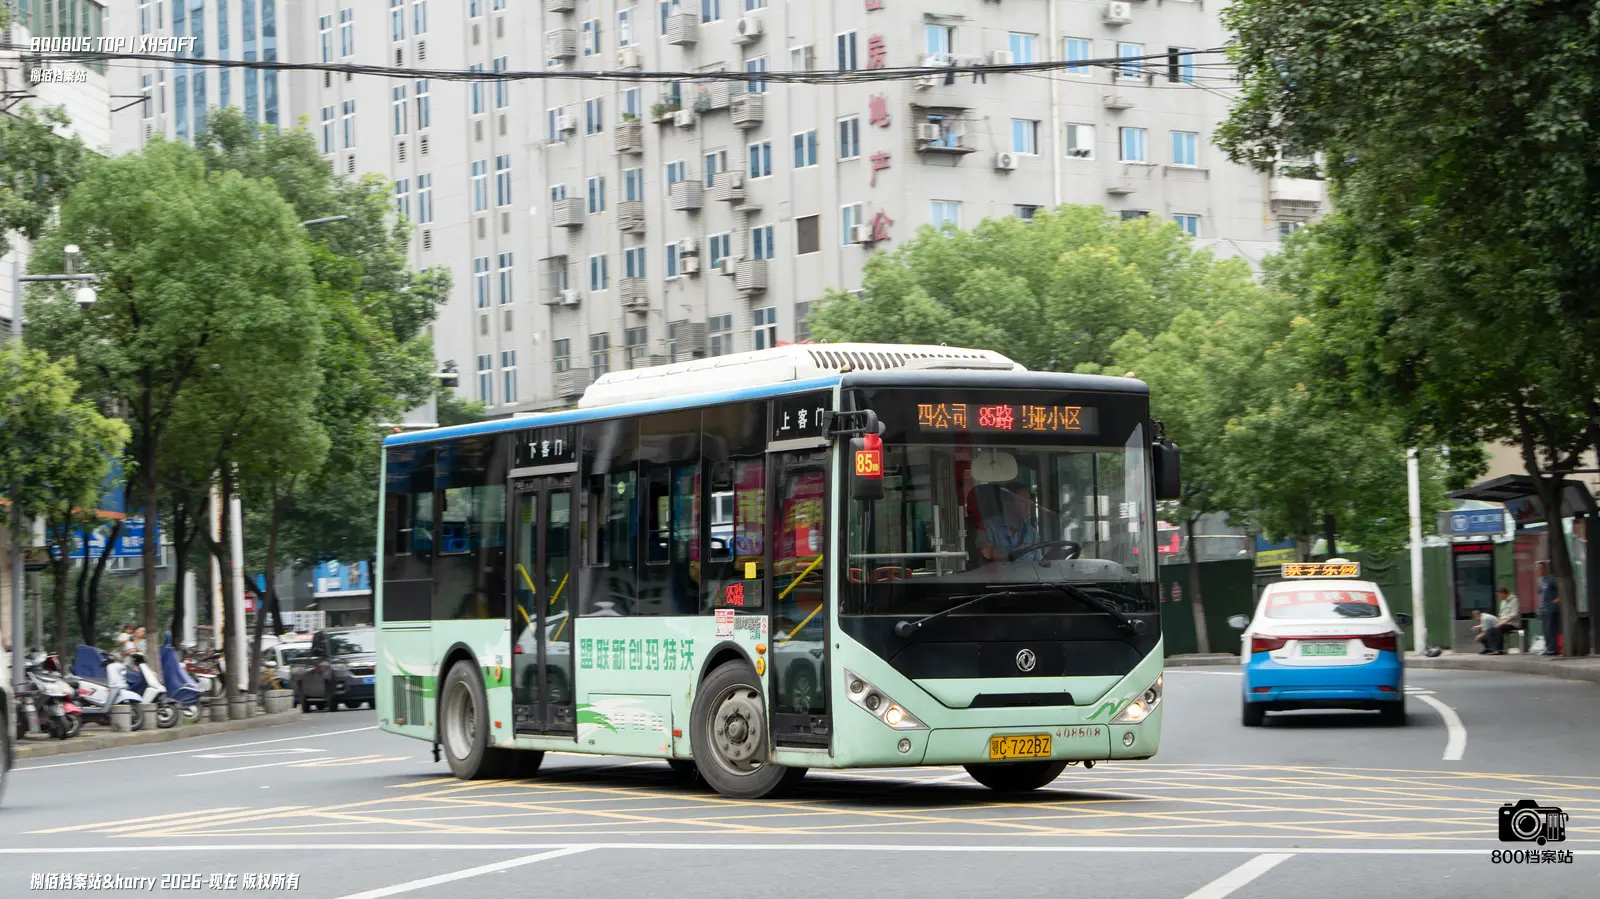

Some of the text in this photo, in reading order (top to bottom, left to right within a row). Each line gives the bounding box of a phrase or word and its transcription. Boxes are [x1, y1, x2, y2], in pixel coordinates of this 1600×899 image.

[781, 407, 824, 431] 上客门
[918, 404, 967, 429] 四公司
[979, 405, 1013, 430] 85路
[528, 439, 563, 459] 下客门
